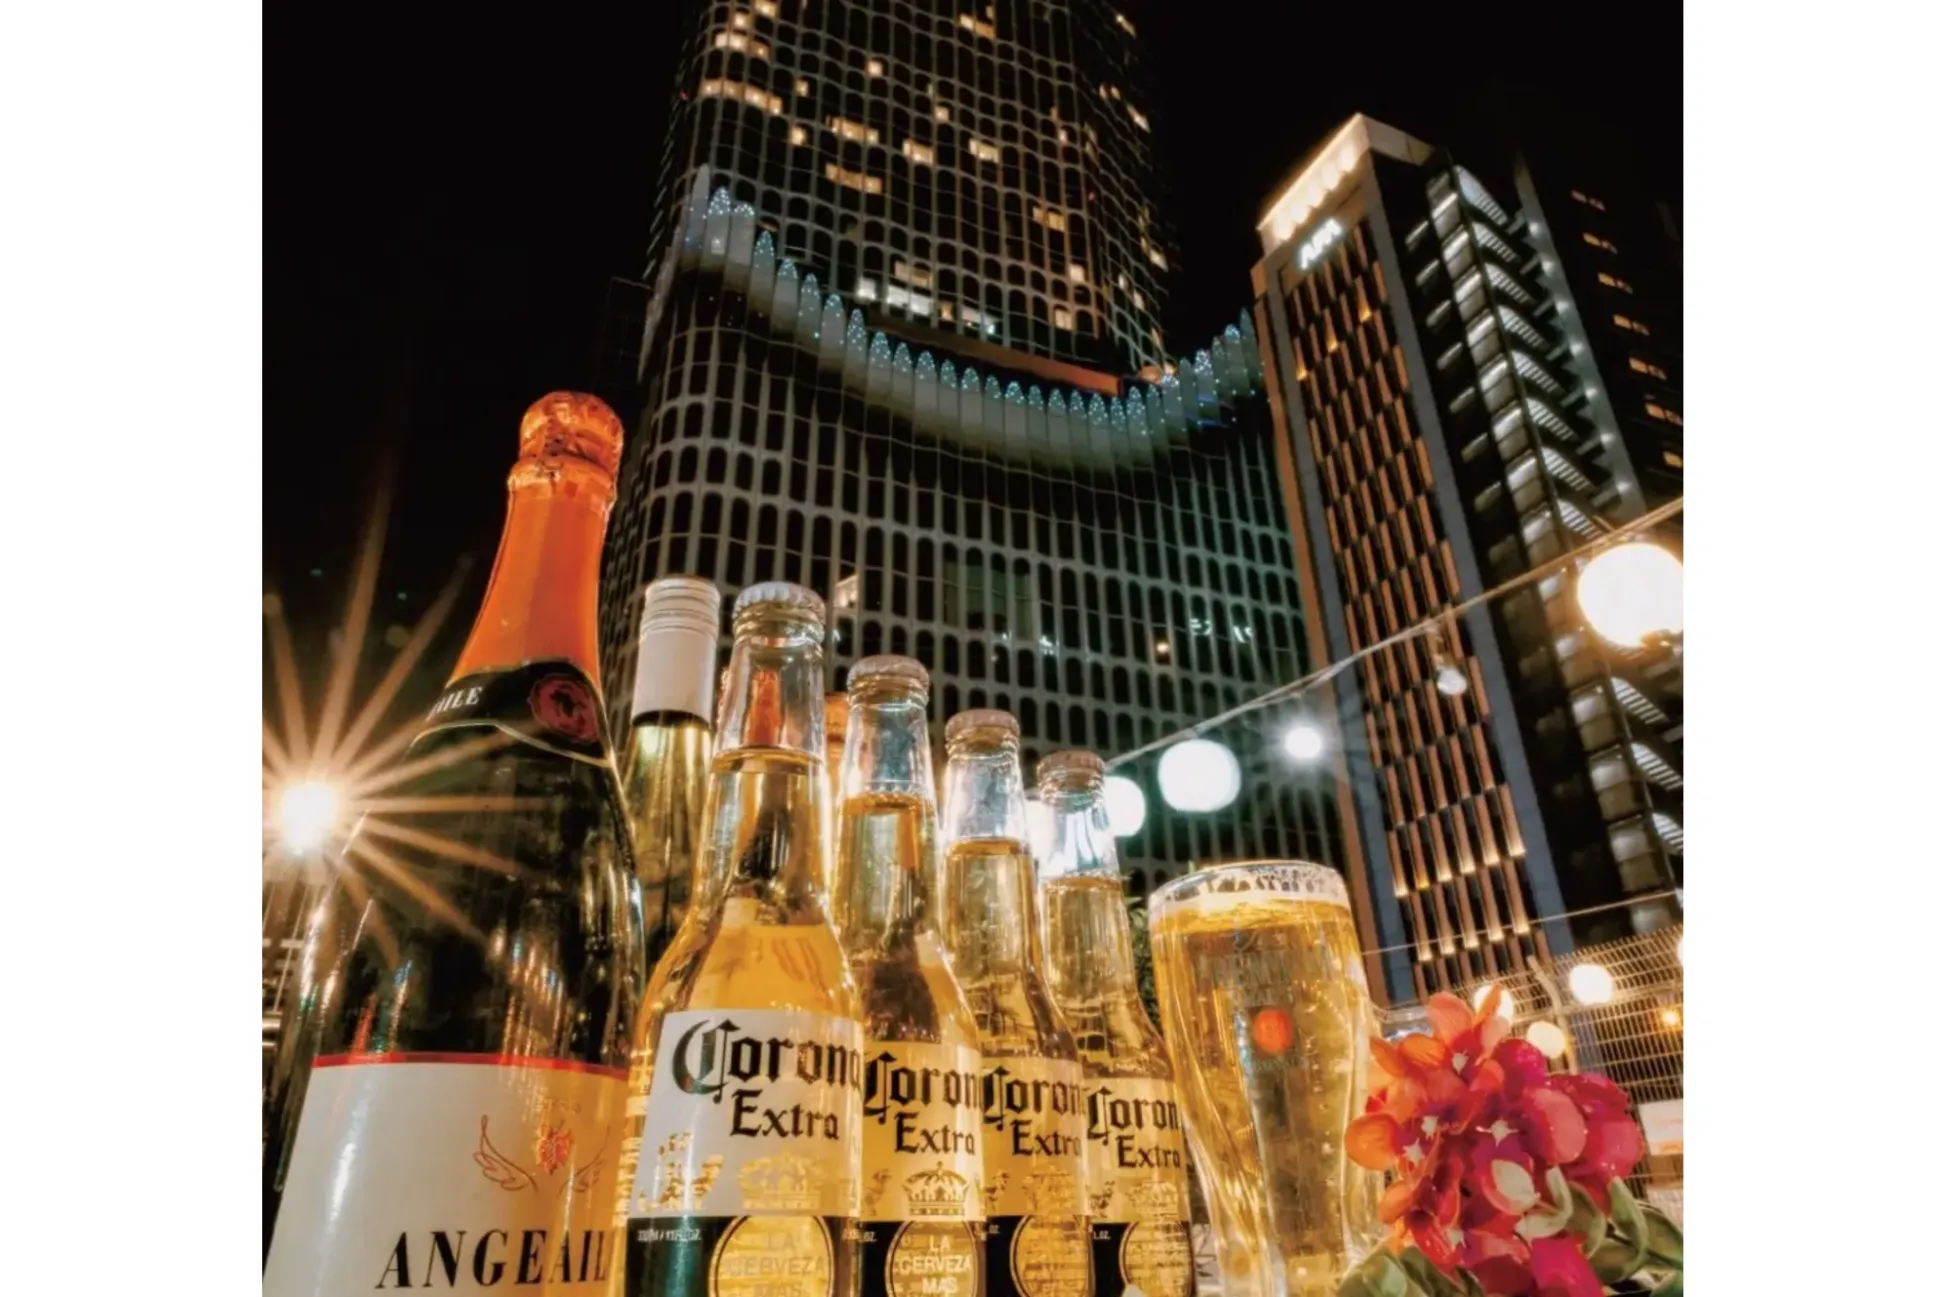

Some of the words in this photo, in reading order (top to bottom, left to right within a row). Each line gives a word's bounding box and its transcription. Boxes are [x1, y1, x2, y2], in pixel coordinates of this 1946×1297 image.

[427, 686, 483, 721] AILE
[863, 1051, 982, 1124] Coron
[982, 1066, 1086, 1131] Coron
[729, 1088, 840, 1141] Extra
[894, 1111, 976, 1155] Extra
[1087, 1086, 1180, 1146] Coron
[1116, 1135, 1181, 1169] Extra
[374, 1228, 612, 1289] ANGEAIL
[899, 1254, 972, 1274] CERVEZA
[929, 1235, 951, 1252] LA
